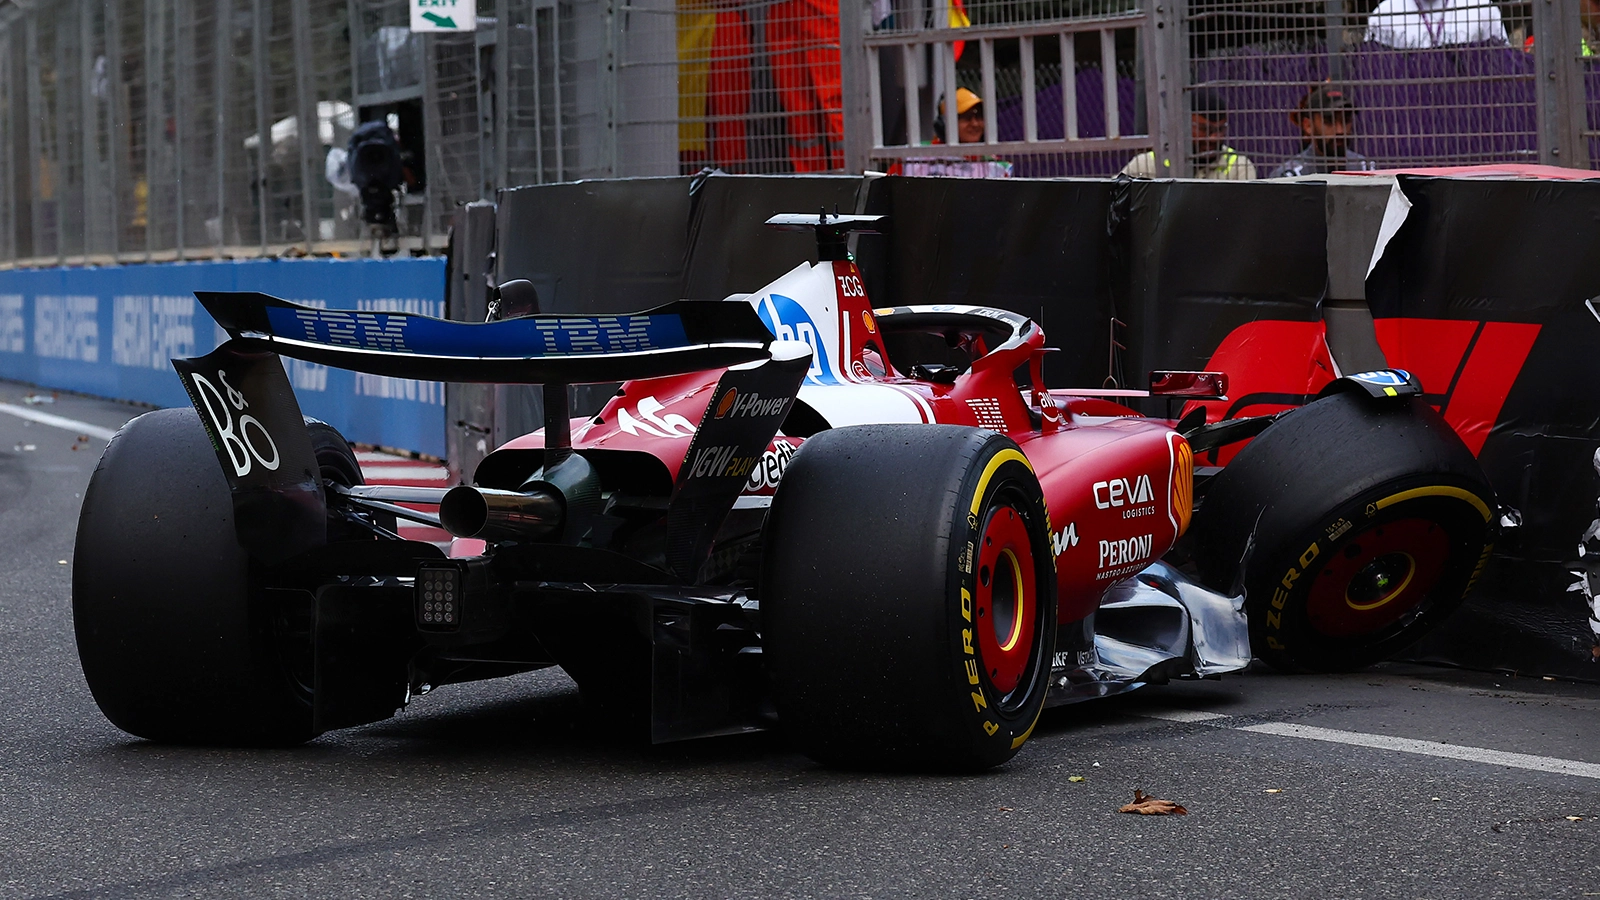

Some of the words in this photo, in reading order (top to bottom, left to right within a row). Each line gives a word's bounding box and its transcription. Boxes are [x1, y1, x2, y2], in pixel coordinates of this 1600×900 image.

[295, 309, 414, 352] IBM
[535, 315, 660, 356] IBM
[617, 396, 697, 438] 16
[730, 393, 790, 418] V-Power
[965, 398, 1009, 433] IBM
[1122, 506, 1155, 519] LOGISTICS
[1098, 534, 1153, 569] PERONI
[1266, 542, 1320, 630] ZERO
[961, 587, 988, 713] ZERO
